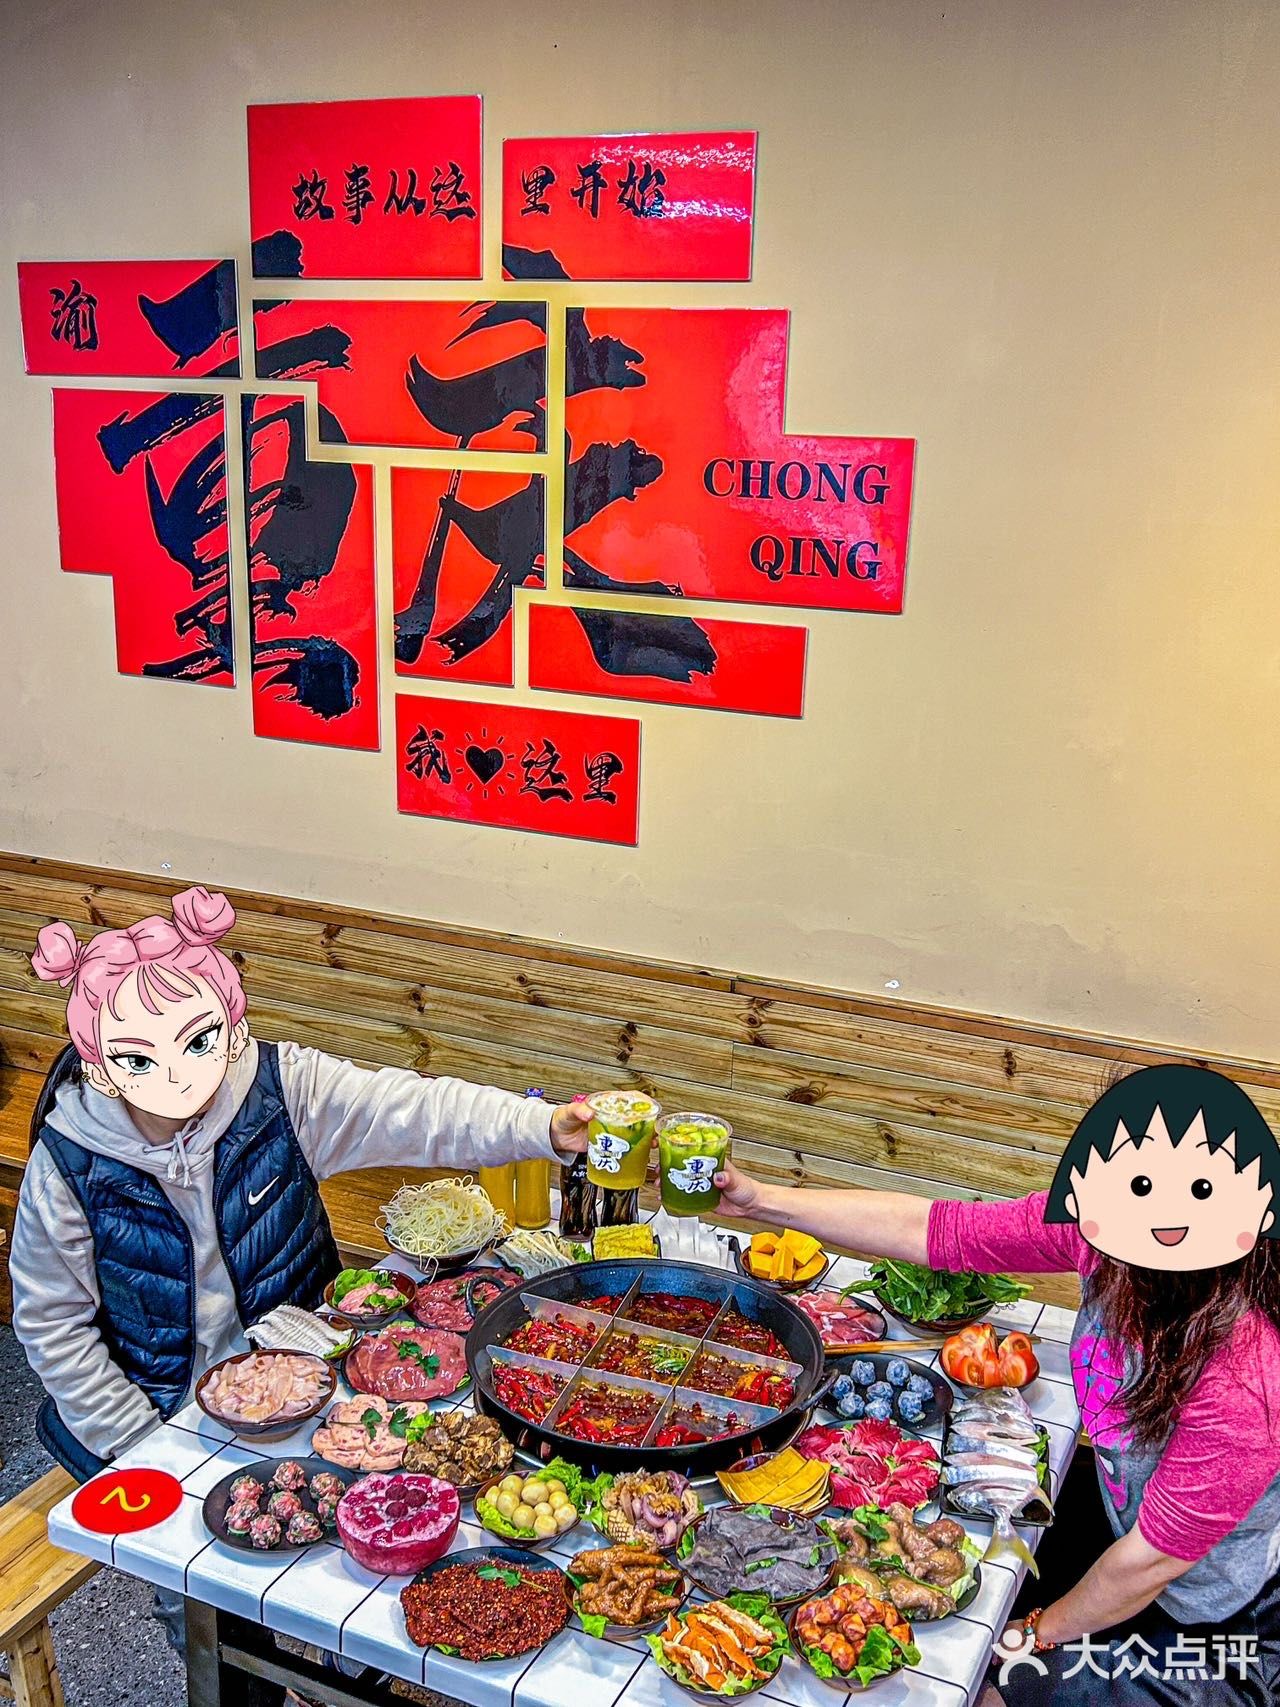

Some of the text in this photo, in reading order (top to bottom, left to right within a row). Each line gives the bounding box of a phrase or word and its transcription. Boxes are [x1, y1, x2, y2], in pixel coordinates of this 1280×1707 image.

[50, 280, 99, 351] 渝
[704, 459, 890, 504] CHONG
[750, 535, 882, 581] QING
